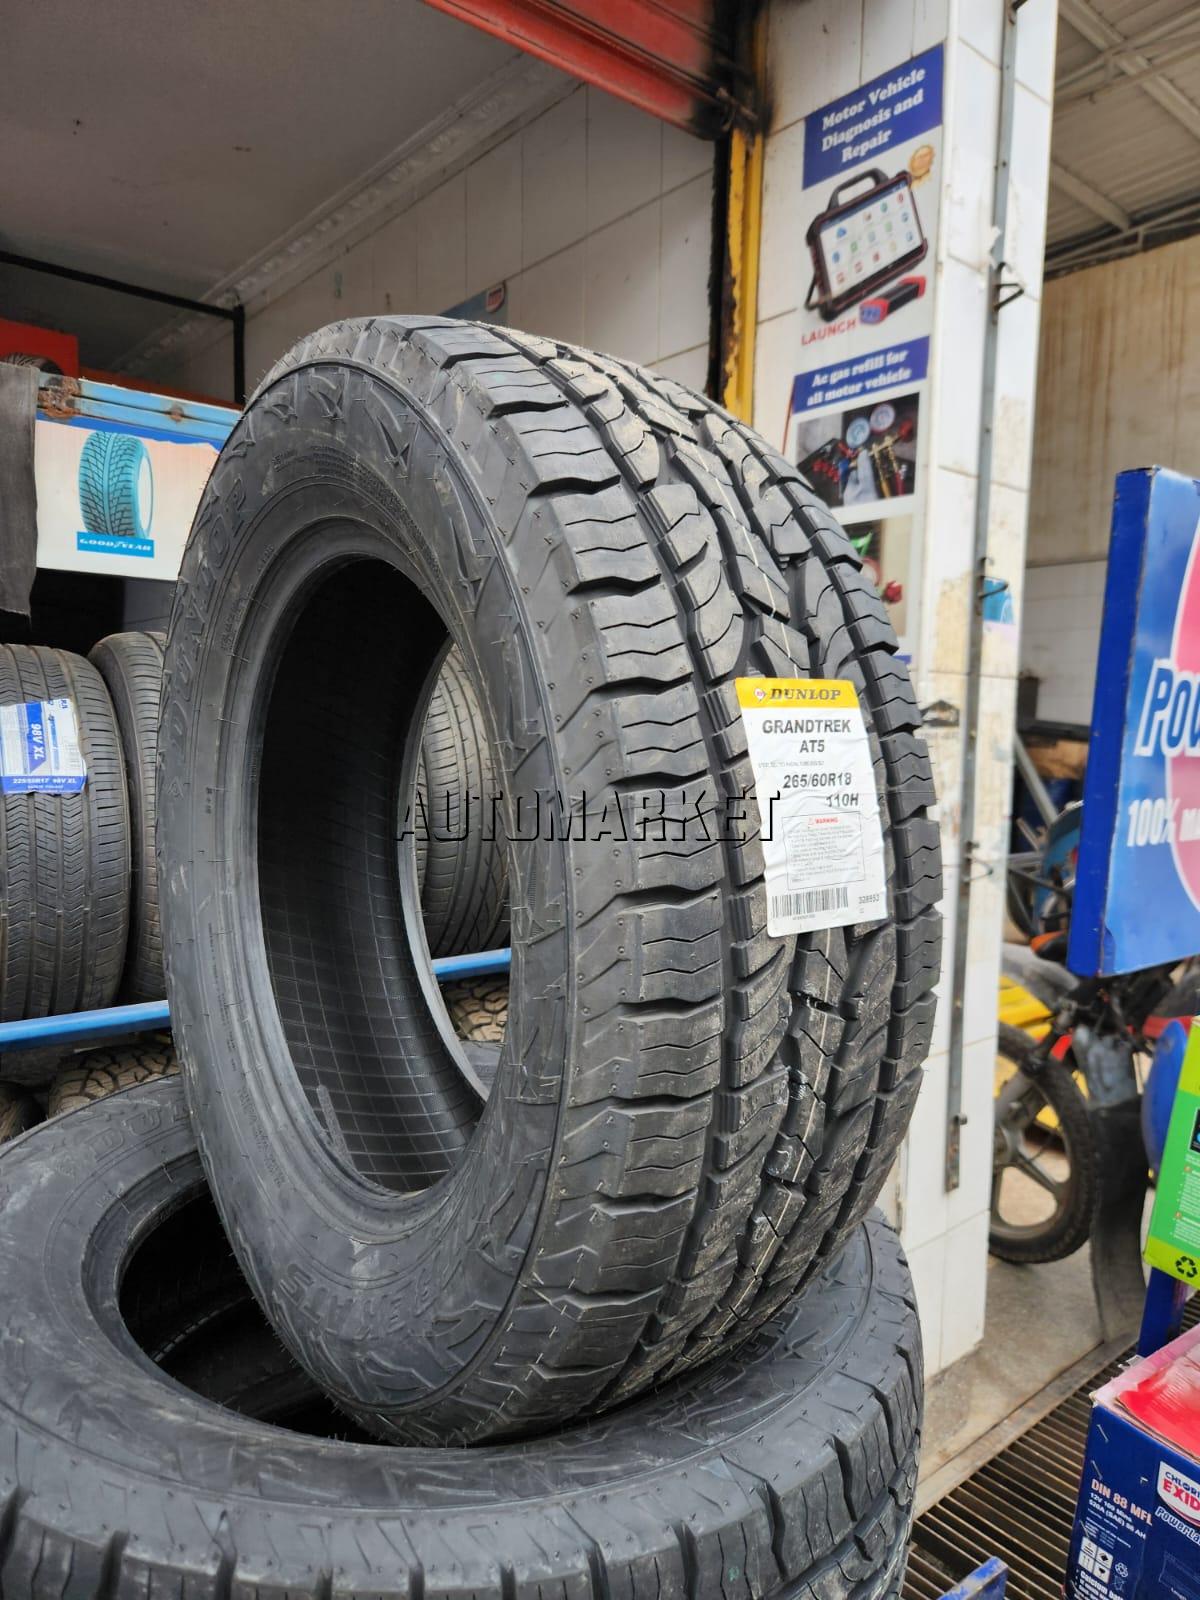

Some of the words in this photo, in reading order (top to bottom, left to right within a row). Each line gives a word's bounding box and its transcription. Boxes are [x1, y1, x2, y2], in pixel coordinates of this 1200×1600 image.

[822, 100, 866, 131] Motor
[868, 68, 926, 105] Vehicle
[821, 108, 892, 152] Diagnosis
[894, 89, 924, 116] and
[842, 129, 892, 163] Repair
[801, 318, 857, 346] LAUNCH
[812, 374, 828, 387] Ac
[829, 369, 850, 387] gas
[852, 354, 885, 377] refill
[886, 350, 908, 364] for
[825, 383, 862, 402] motor
[864, 368, 912, 390] vehicle
[769, 687, 842, 701] DUNLOP
[762, 719, 851, 734] GRANDTREK
[799, 740, 825, 753] AT5
[783, 772, 852, 789] 265/60R18
[826, 793, 859, 808] 110H
[1126, 798, 1181, 848] 100%
[1091, 1478, 1111, 1499] DIN
[1113, 1493, 1128, 1509] 88
[1130, 1502, 1153, 1527] MFL
[1163, 1478, 1200, 1512] EXID
[1154, 1506, 1200, 1546] PowerLa
